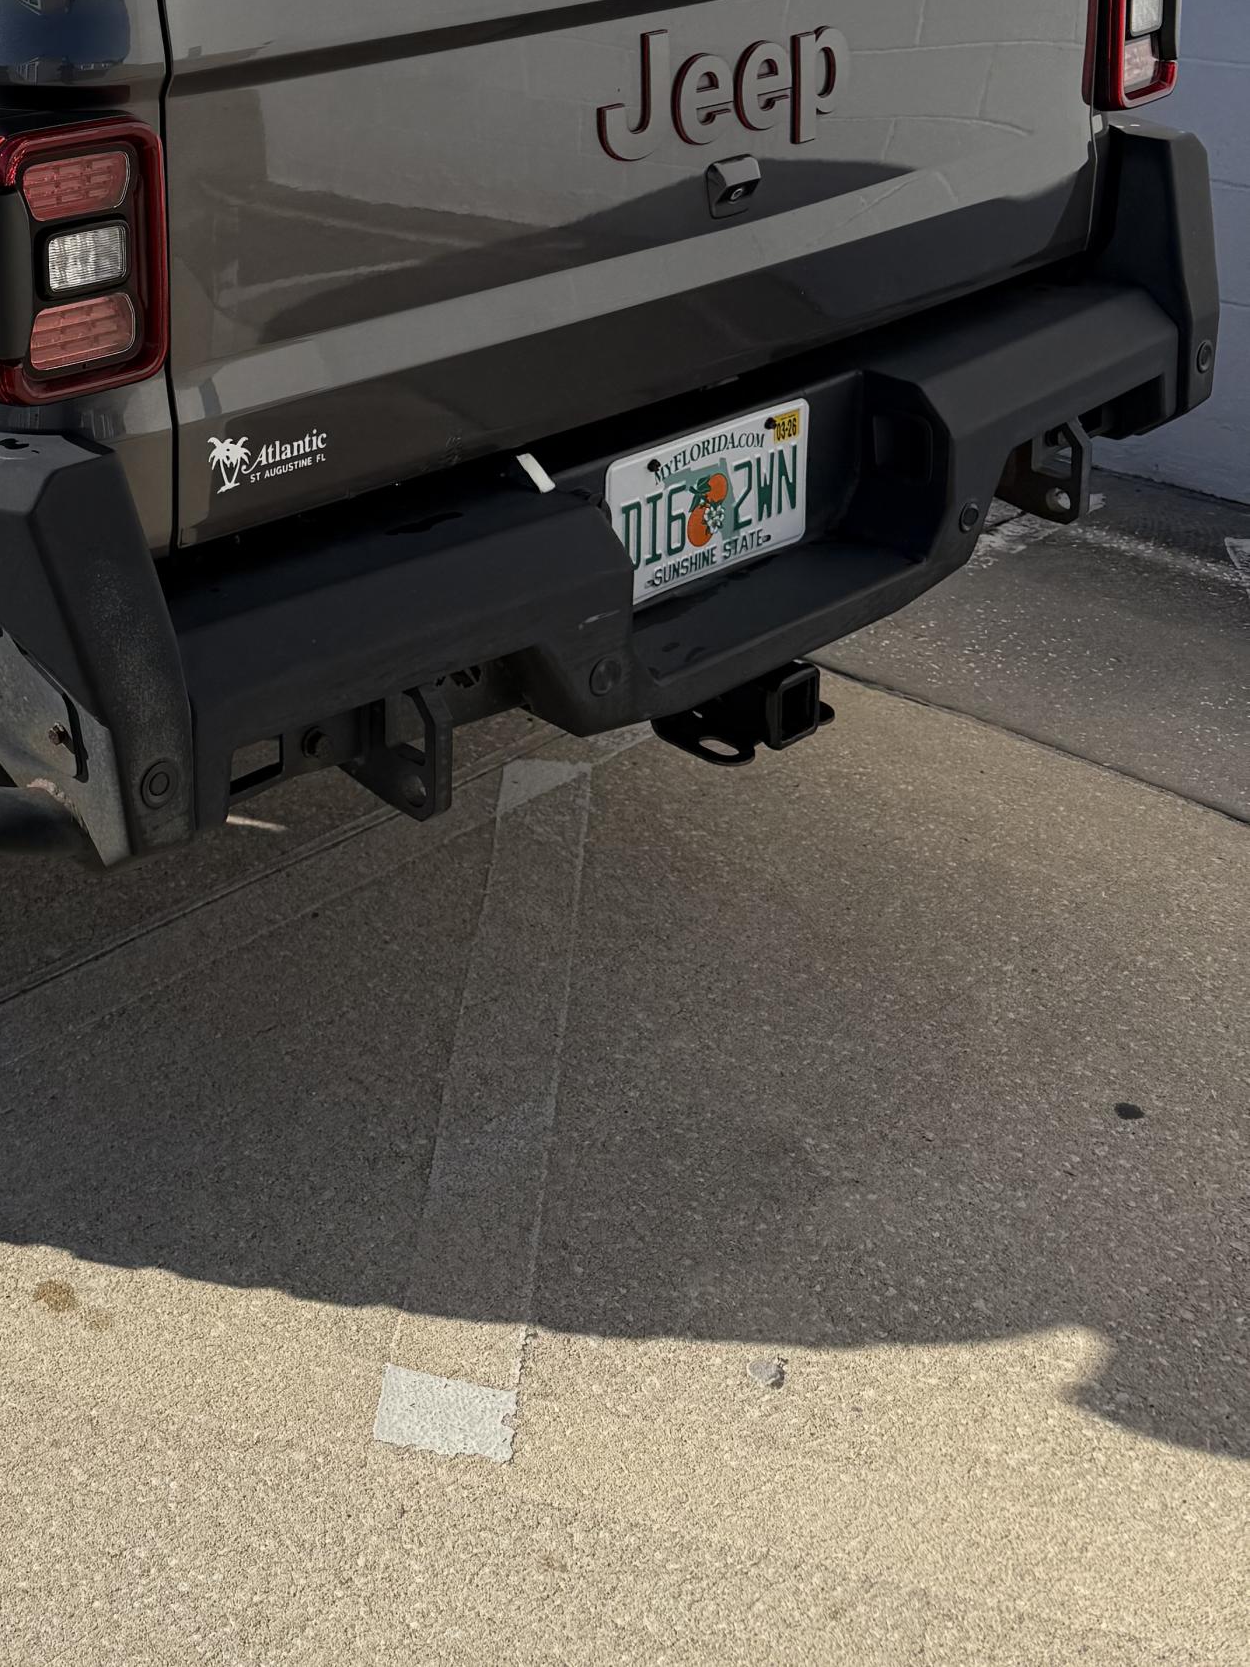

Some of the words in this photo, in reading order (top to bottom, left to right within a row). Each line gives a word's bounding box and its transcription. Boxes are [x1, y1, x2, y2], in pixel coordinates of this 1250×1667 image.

[597, 25, 849, 162] Jeep
[241, 428, 327, 474] Atlantic
[776, 417, 798, 441] 03-26
[250, 472, 261, 483] ST
[264, 456, 313, 479] AUGUSTINE
[316, 453, 327, 463] FL
[653, 545, 717, 586] SUNSHINE
[723, 529, 763, 560] STATE
